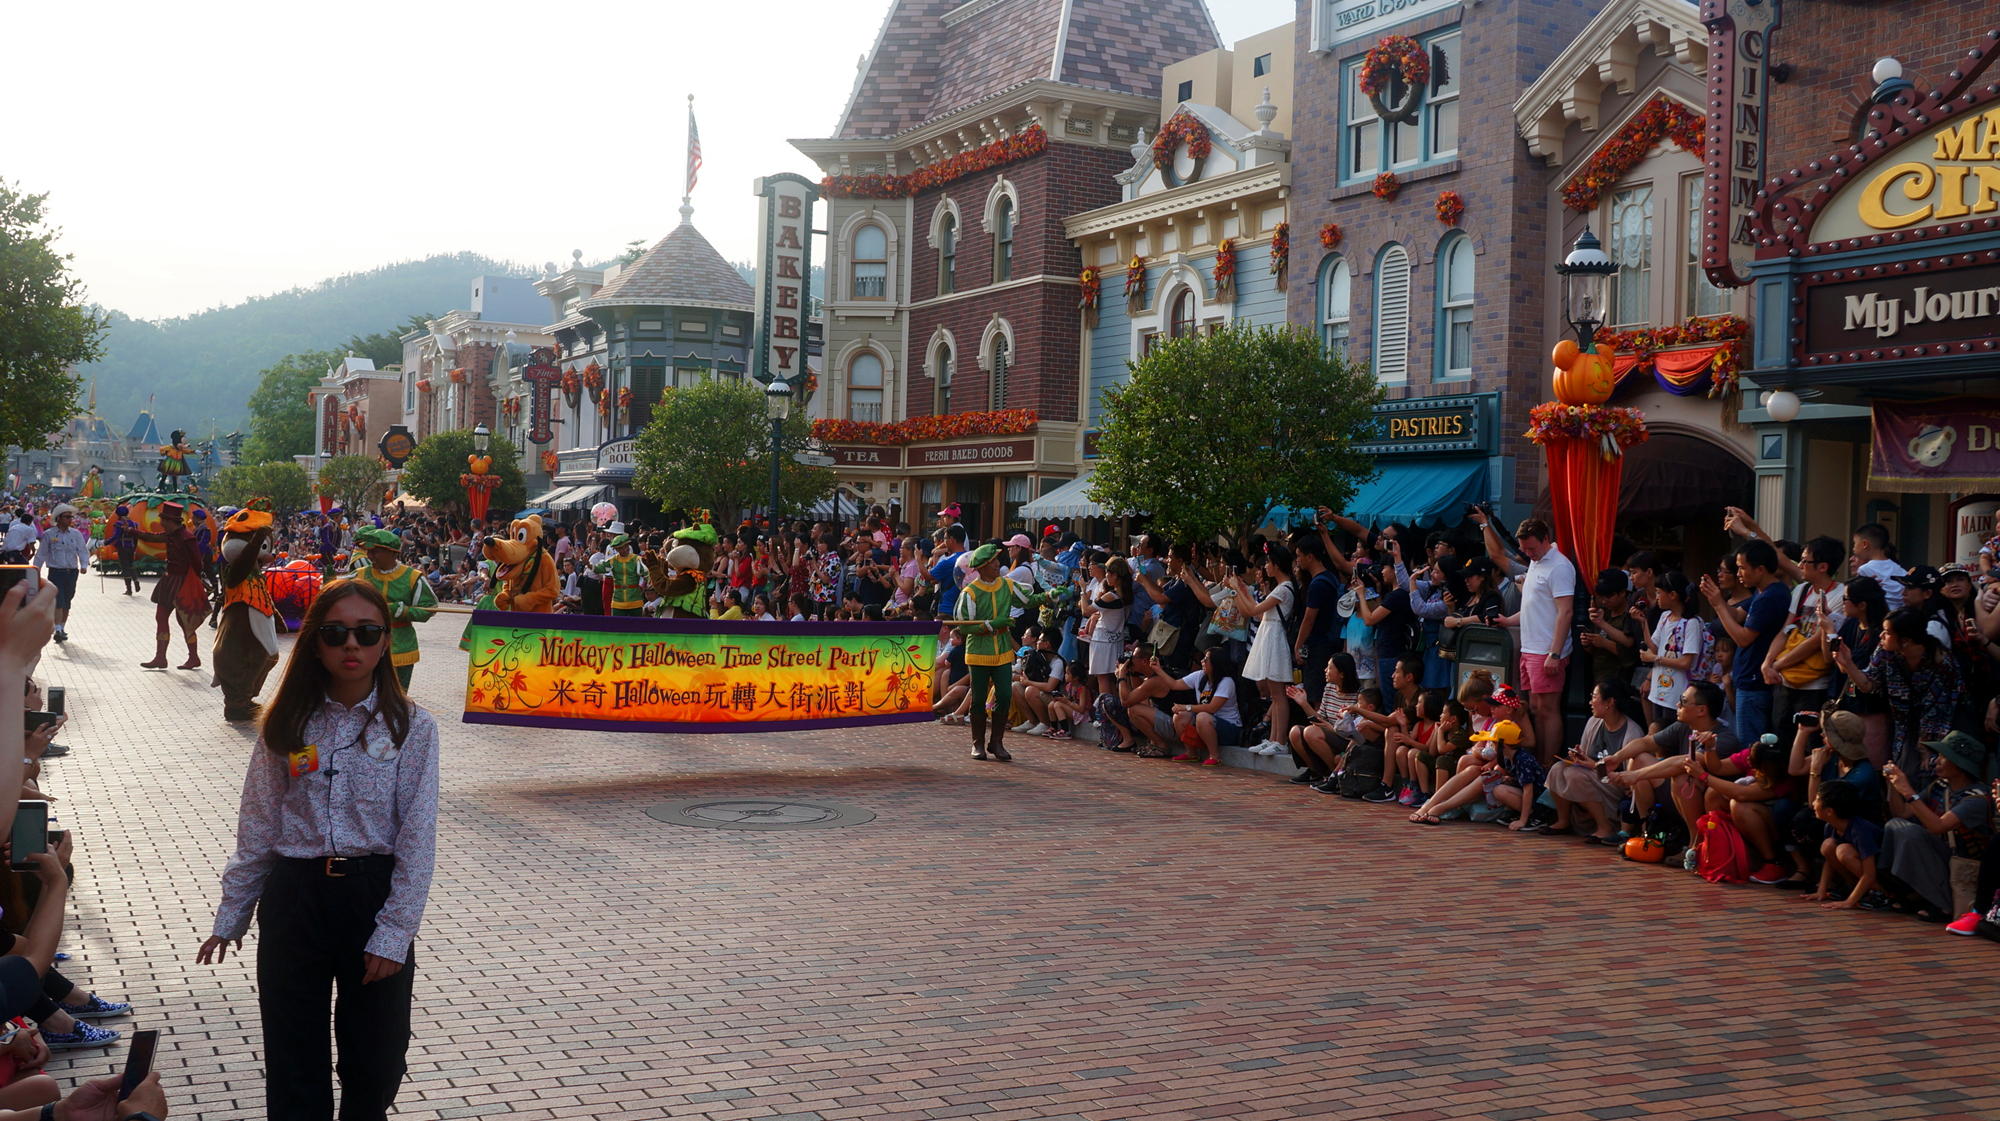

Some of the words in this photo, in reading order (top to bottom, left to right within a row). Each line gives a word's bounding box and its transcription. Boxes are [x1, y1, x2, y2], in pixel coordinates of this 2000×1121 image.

[1730, 30, 1764, 245] CINEMA
[1858, 162, 2000, 230] CIN
[773, 194, 803, 369] BAKERY
[1843, 292, 1902, 338] My
[1904, 286, 2000, 326] Jour
[530, 368, 558, 379] Fine
[537, 377, 548, 439] COLLECTIBLES
[1389, 415, 1464, 439] PASTRIES
[1967, 424, 2000, 451] D
[609, 453, 636, 464] BOU
[844, 451, 880, 463] TEA
[925, 450, 950, 462] FRESH
[952, 448, 978, 460] BAKED
[981, 446, 1013, 459] GOODS
[1960, 515, 1993, 536] MAIN
[537, 636, 624, 675] Mickey's
[628, 642, 717, 669] Halloween
[720, 644, 763, 669] Time
[767, 644, 823, 670] Street
[827, 646, 881, 676] Party
[547, 678, 608, 709] 米奇
[611, 678, 702, 710] Halloween
[703, 681, 866, 714] 玩轉大街派對
